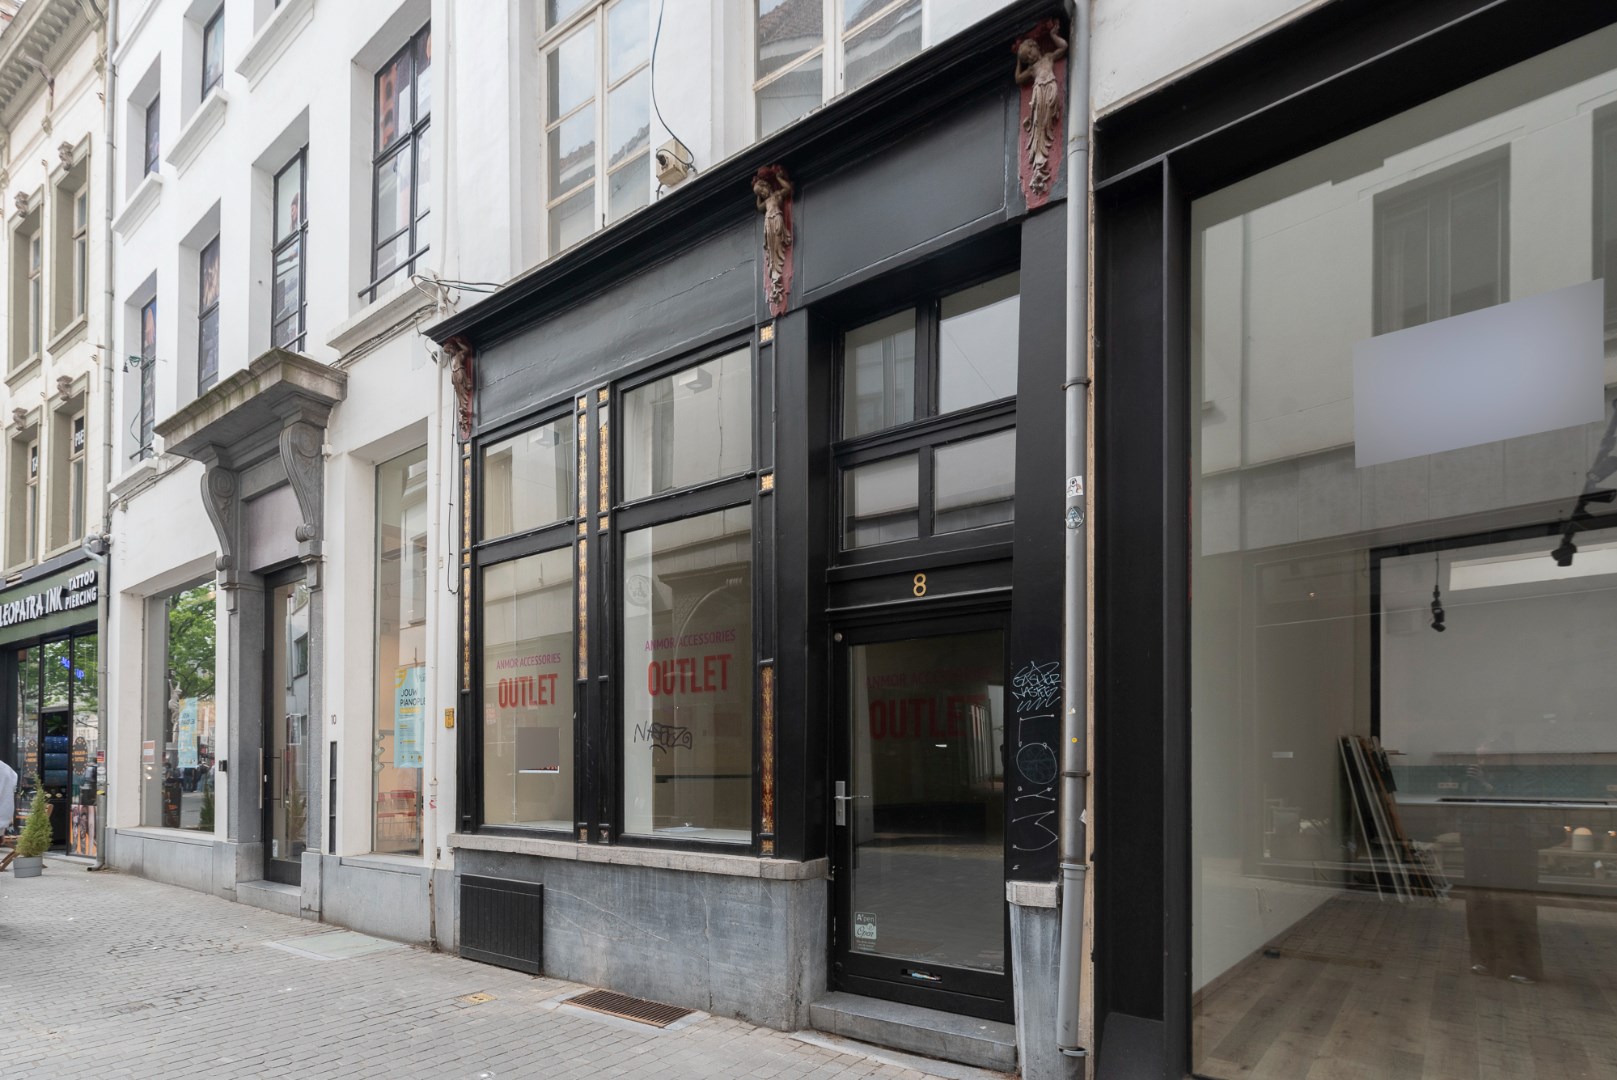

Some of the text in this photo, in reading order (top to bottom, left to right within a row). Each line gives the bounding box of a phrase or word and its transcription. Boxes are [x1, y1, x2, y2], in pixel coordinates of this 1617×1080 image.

[68, 569, 95, 591] TATTOO
[913, 573, 927, 597] 8
[45, 585, 63, 614] INK
[65, 586, 98, 610] PIERCING
[644, 629, 737, 652] ANMOR ACCESSORIES
[496, 652, 561, 670] ANMOR ACCESSORIES
[647, 653, 733, 697] OUTLET
[498, 673, 558, 708] OUTLET
[330, 714, 337, 725] 10
[869, 693, 987, 741] OUTLET
[856, 925, 874, 938] Open
